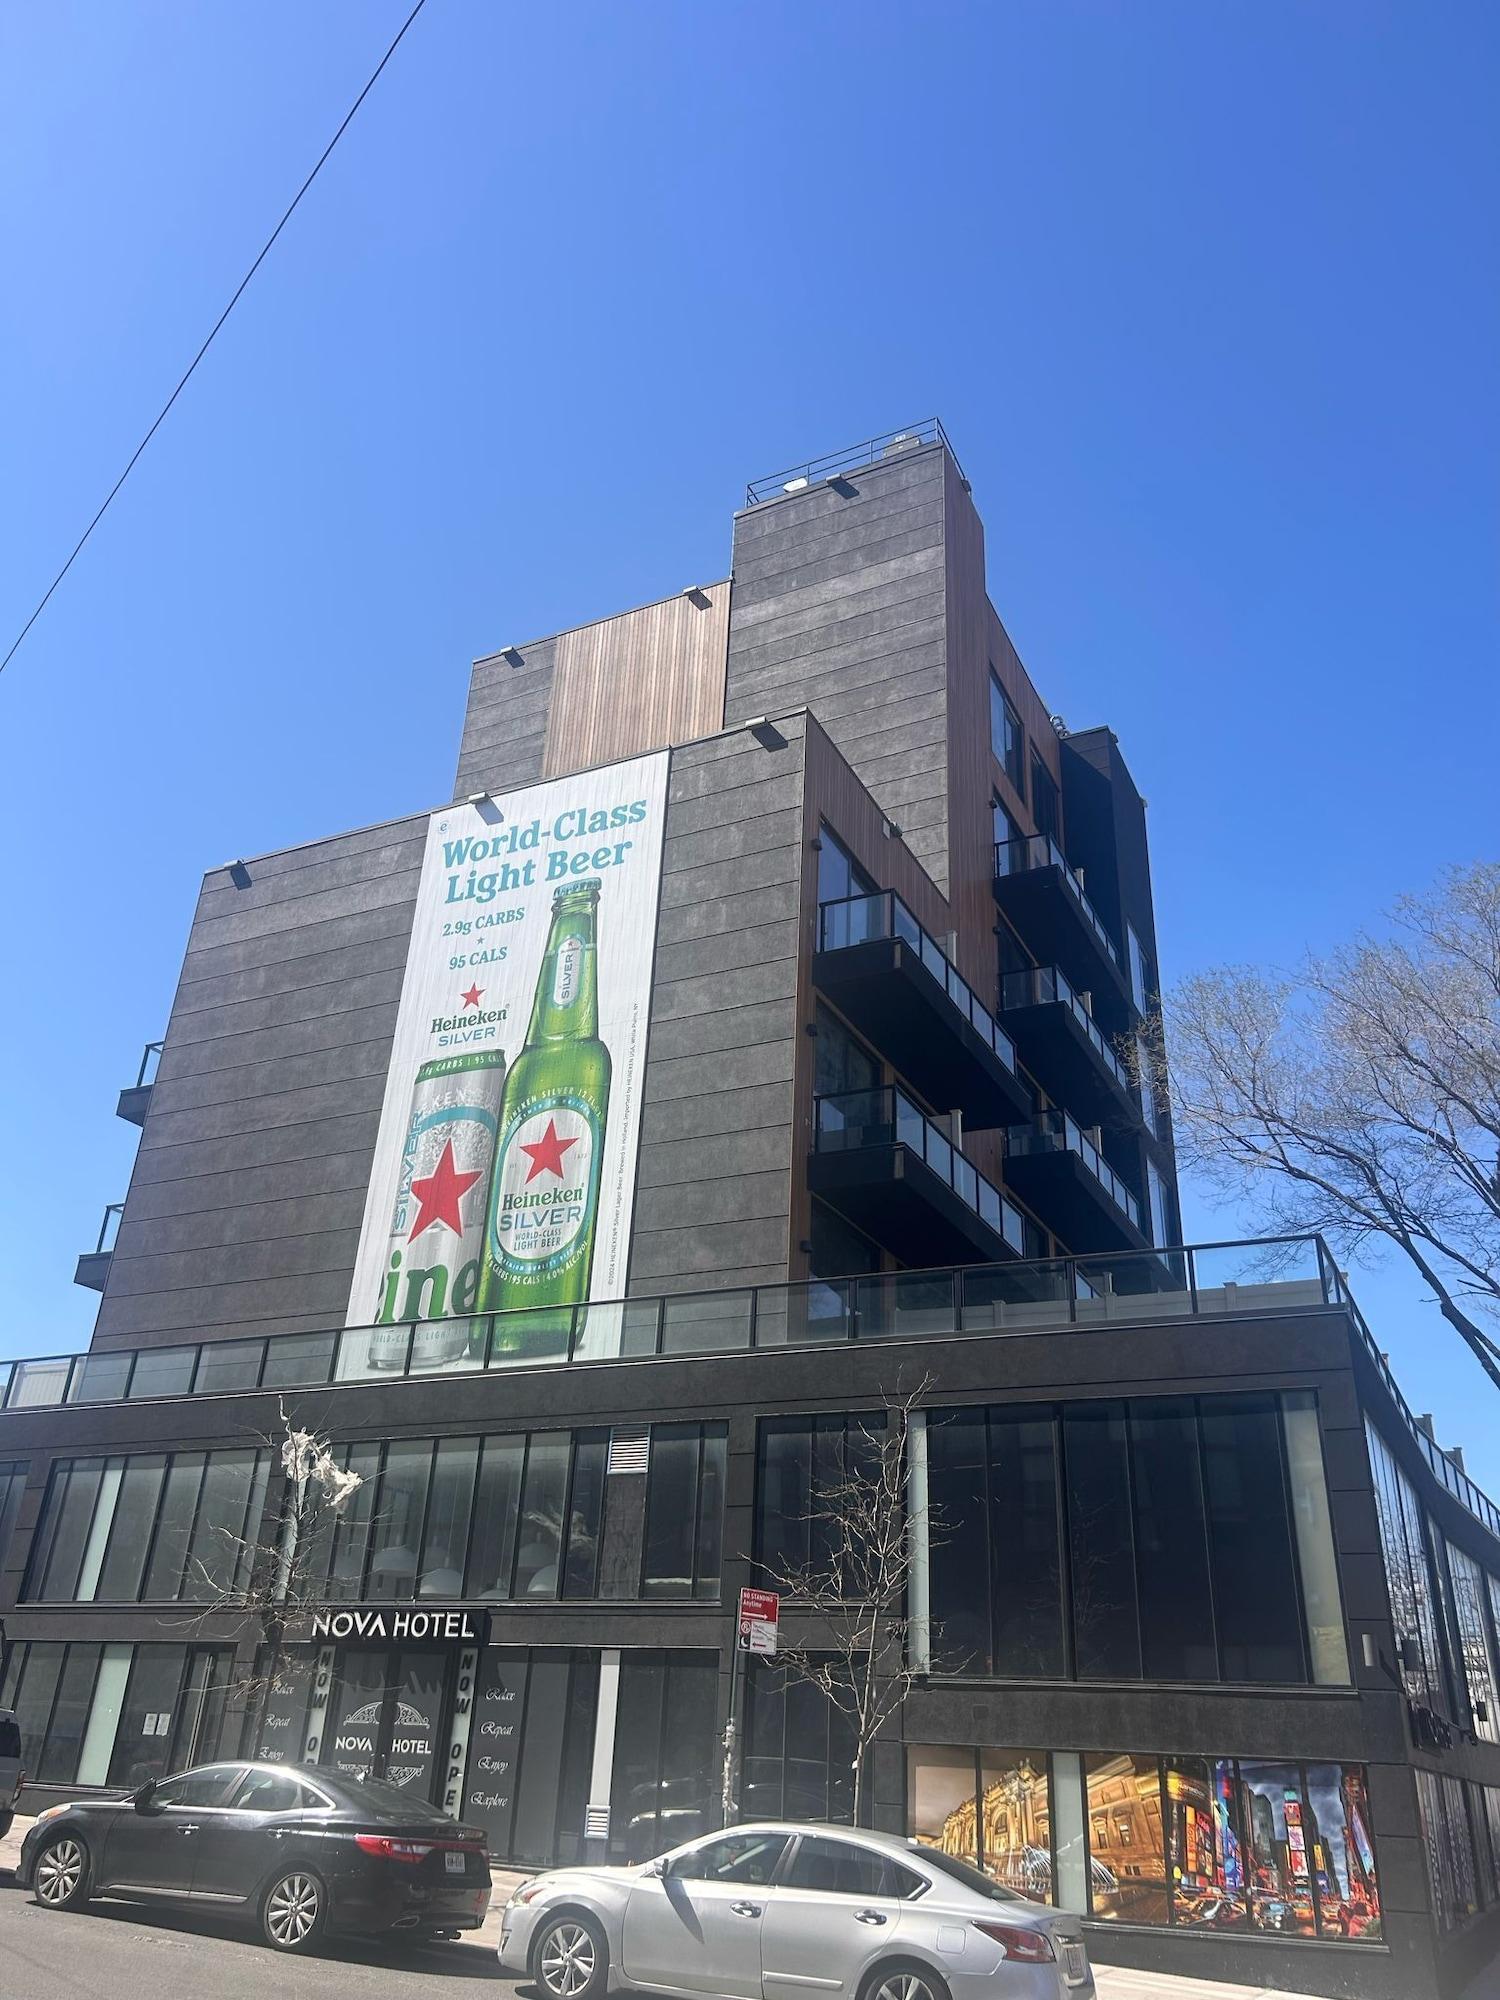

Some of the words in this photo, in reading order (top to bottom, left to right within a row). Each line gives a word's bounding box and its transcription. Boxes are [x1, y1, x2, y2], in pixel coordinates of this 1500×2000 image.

[443, 800, 647, 869] World-Class
[445, 859, 535, 904] Light
[544, 841, 633, 882] Beer
[442, 919, 472, 937] 2.9g
[475, 907, 525, 931] CARBS
[449, 956, 466, 970] 95
[468, 946, 508, 966] CALS
[561, 954, 574, 1000] SILVER
[430, 1008, 508, 1034] Heineken
[438, 1026, 496, 1047] SILVER
[394, 1111, 424, 1231] SILVER
[502, 1187, 583, 1211] Heineken
[500, 1205, 581, 1232] SILVER
[514, 1240, 539, 1251] LIGHT
[541, 1236, 562, 1248] BEER
[515, 1228, 562, 1241] WORLD-CLASS
[511, 1275, 522, 1285] 95
[311, 1611, 386, 1638] NOVA
[392, 1612, 475, 1638] HOTEL
[312, 1651, 331, 1709] NOW
[455, 1653, 475, 1714] NOW
[485, 1687, 517, 1702] Relax
[480, 1721, 514, 1737] Repeat
[335, 1736, 373, 1752] NOVA
[391, 1739, 432, 1755] HOTEL
[477, 1756, 510, 1775] Enjoy
[444, 1743, 463, 1820] OPE
[470, 1791, 509, 1808] Explore
